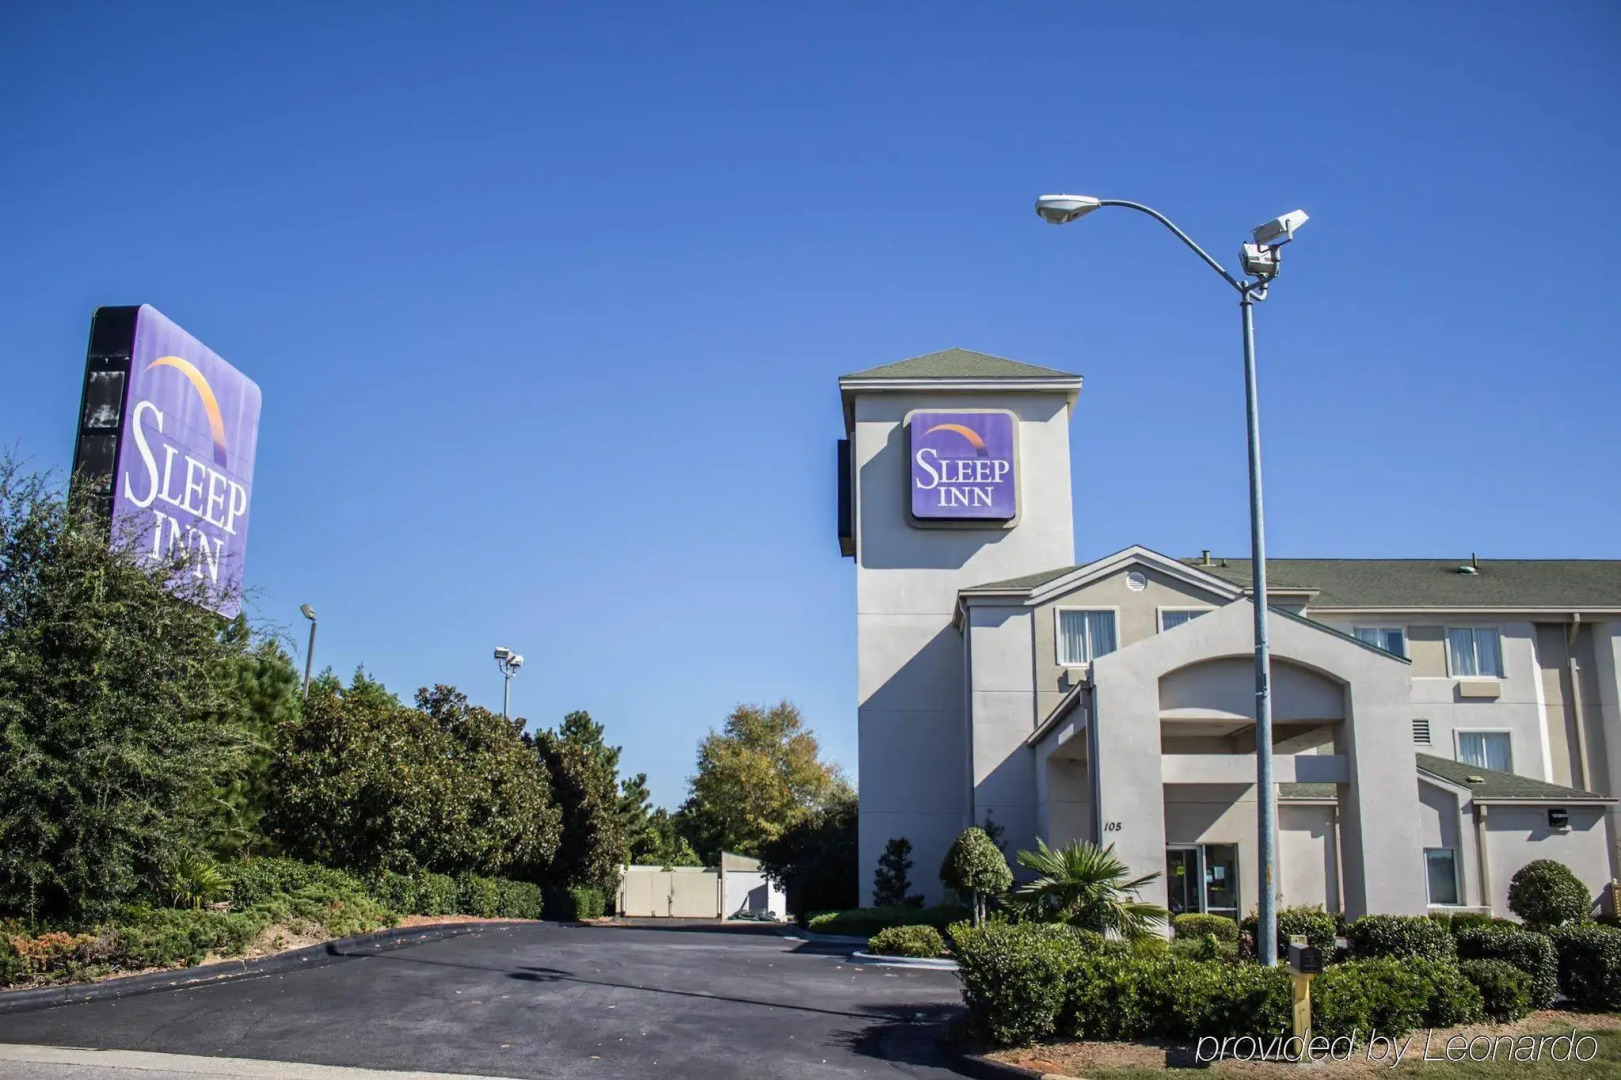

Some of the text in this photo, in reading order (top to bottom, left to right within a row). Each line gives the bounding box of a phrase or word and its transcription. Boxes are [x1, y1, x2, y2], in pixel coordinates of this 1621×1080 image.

[124, 400, 247, 536] SLEEP
[915, 448, 1010, 490] SLEEP
[938, 486, 994, 507] INN
[1104, 822, 1122, 832] 105
